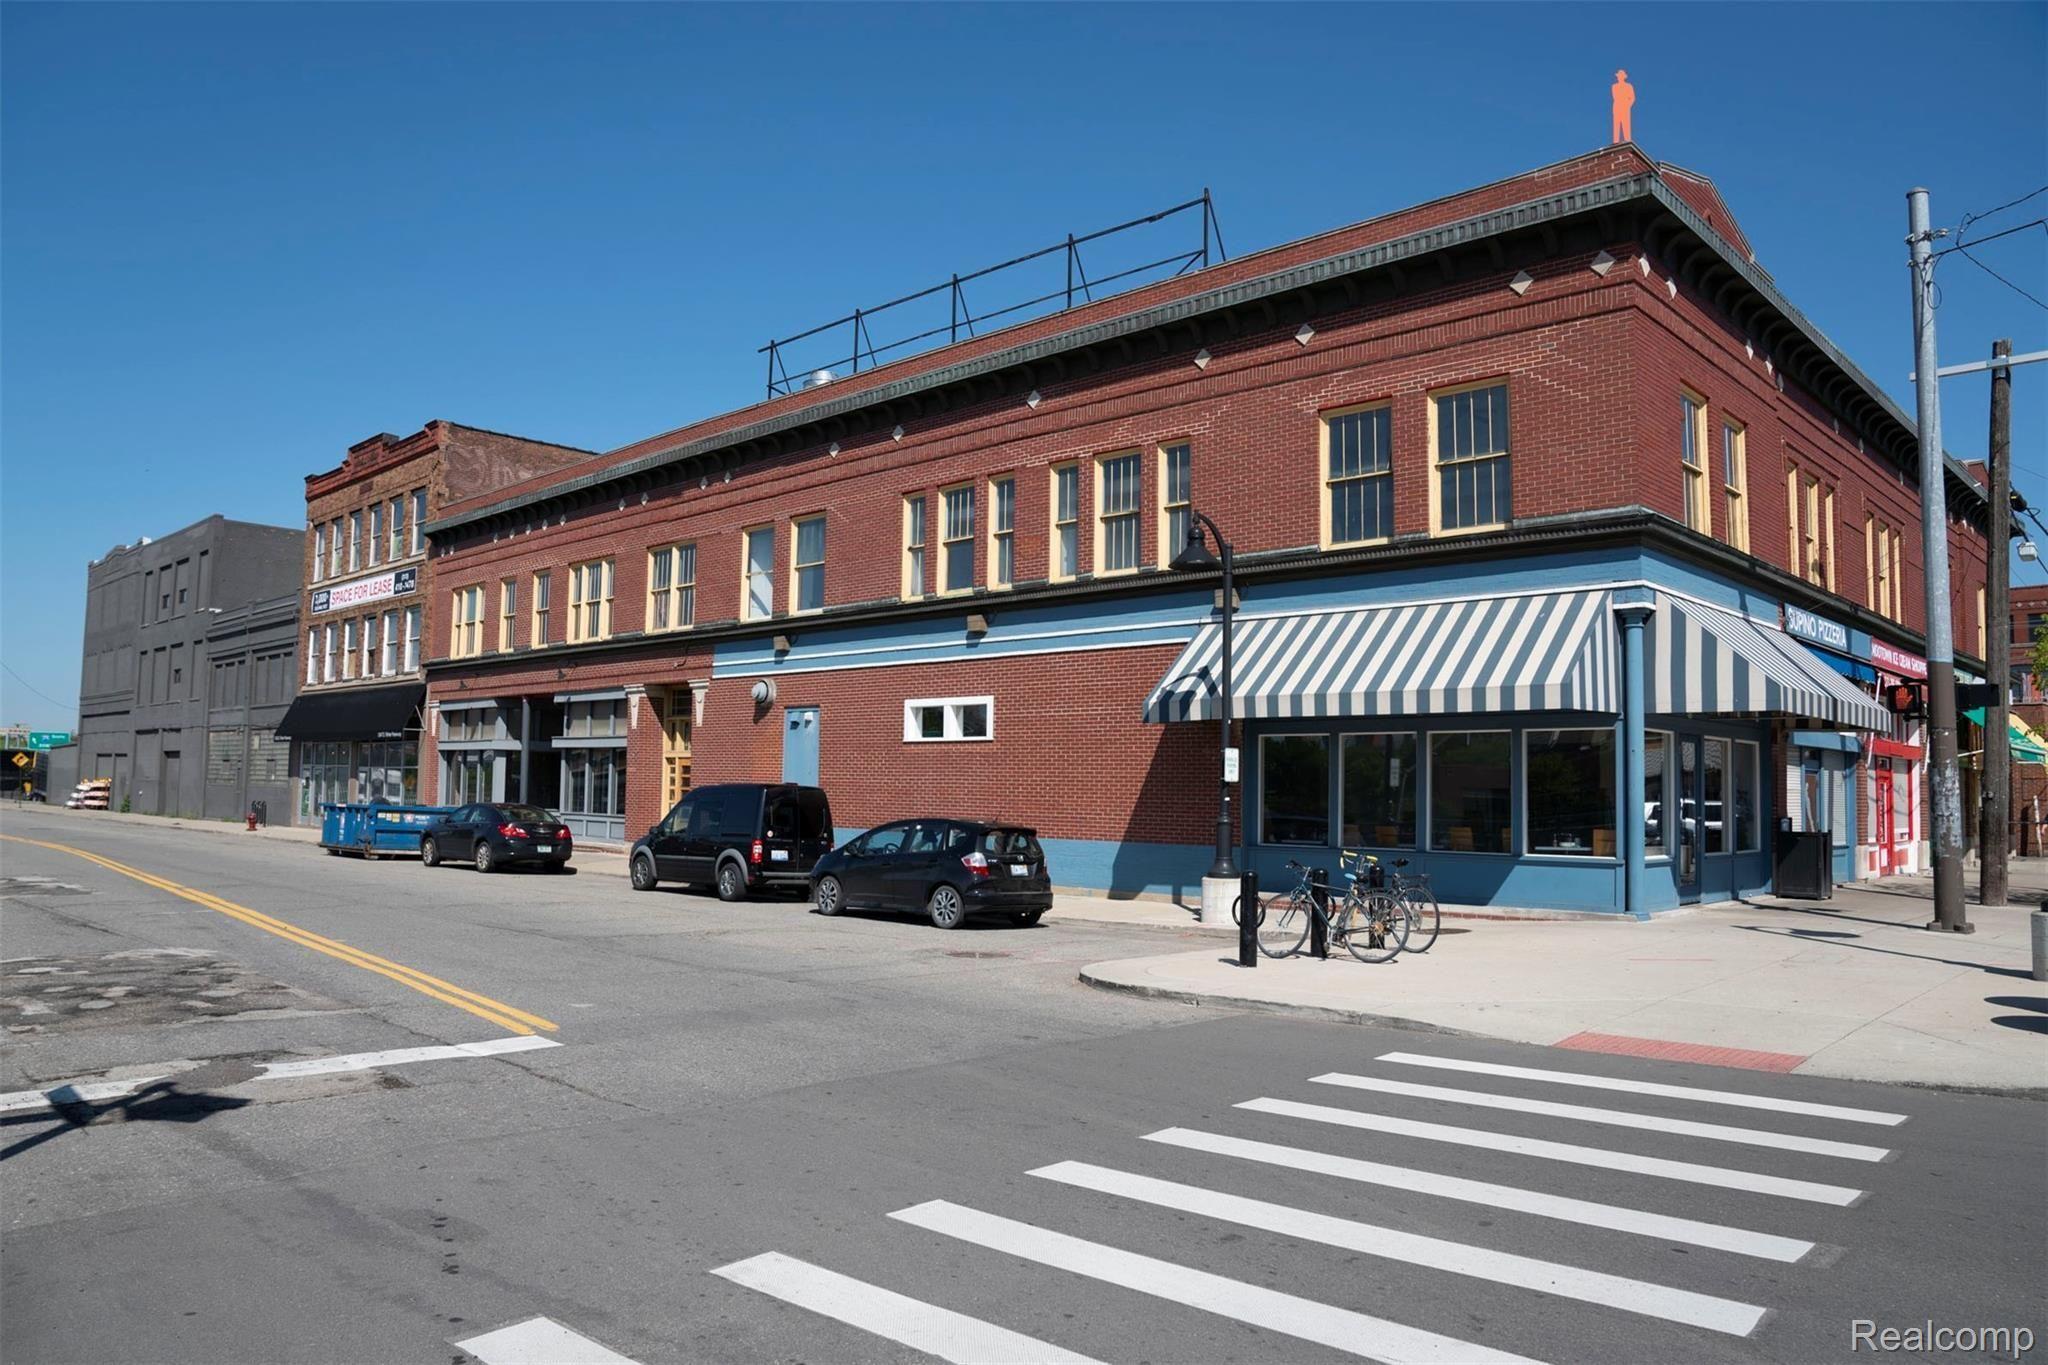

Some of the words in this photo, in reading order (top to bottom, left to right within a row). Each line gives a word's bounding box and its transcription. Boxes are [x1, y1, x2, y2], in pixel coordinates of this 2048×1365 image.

[331, 588, 352, 605] SPACE
[354, 584, 368, 599] FOR
[369, 578, 392, 596] LEASE
[1788, 607, 1817, 637] SUPINO
[1818, 619, 1847, 648] PIZZERIA
